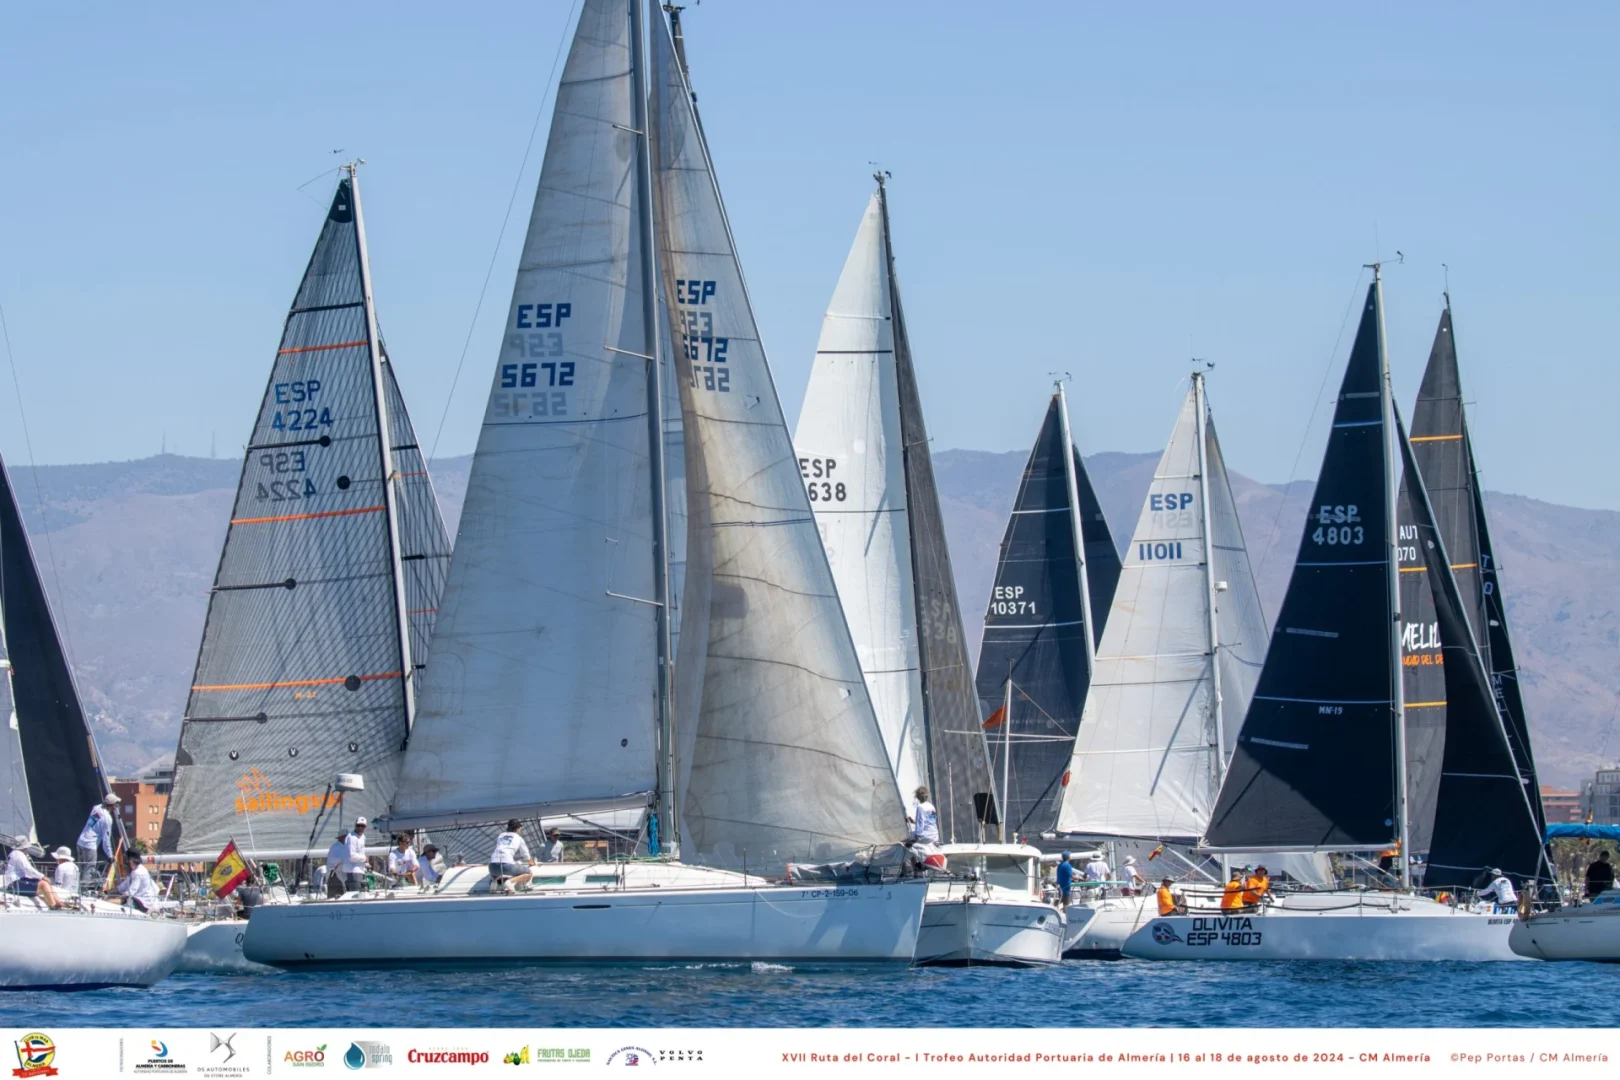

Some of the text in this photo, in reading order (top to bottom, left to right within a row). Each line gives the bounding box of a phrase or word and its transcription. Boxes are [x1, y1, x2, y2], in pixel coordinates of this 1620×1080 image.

[676, 279, 716, 305] ESP
[516, 303, 571, 329] ESP
[501, 362, 575, 388] 5672
[275, 379, 321, 404] ESP
[272, 407, 334, 432] 4224
[799, 458, 837, 478] ESP
[808, 482, 846, 502] 638
[1150, 493, 1193, 511] ESP
[1319, 504, 1358, 524] ESP
[1312, 526, 1364, 546] 4803
[1139, 542, 1182, 560] 11011
[994, 586, 1024, 599] ESP
[990, 601, 1036, 615] 10371
[1192, 917, 1252, 931] OLIVITA
[1187, 932, 1262, 945] ESP 4803
